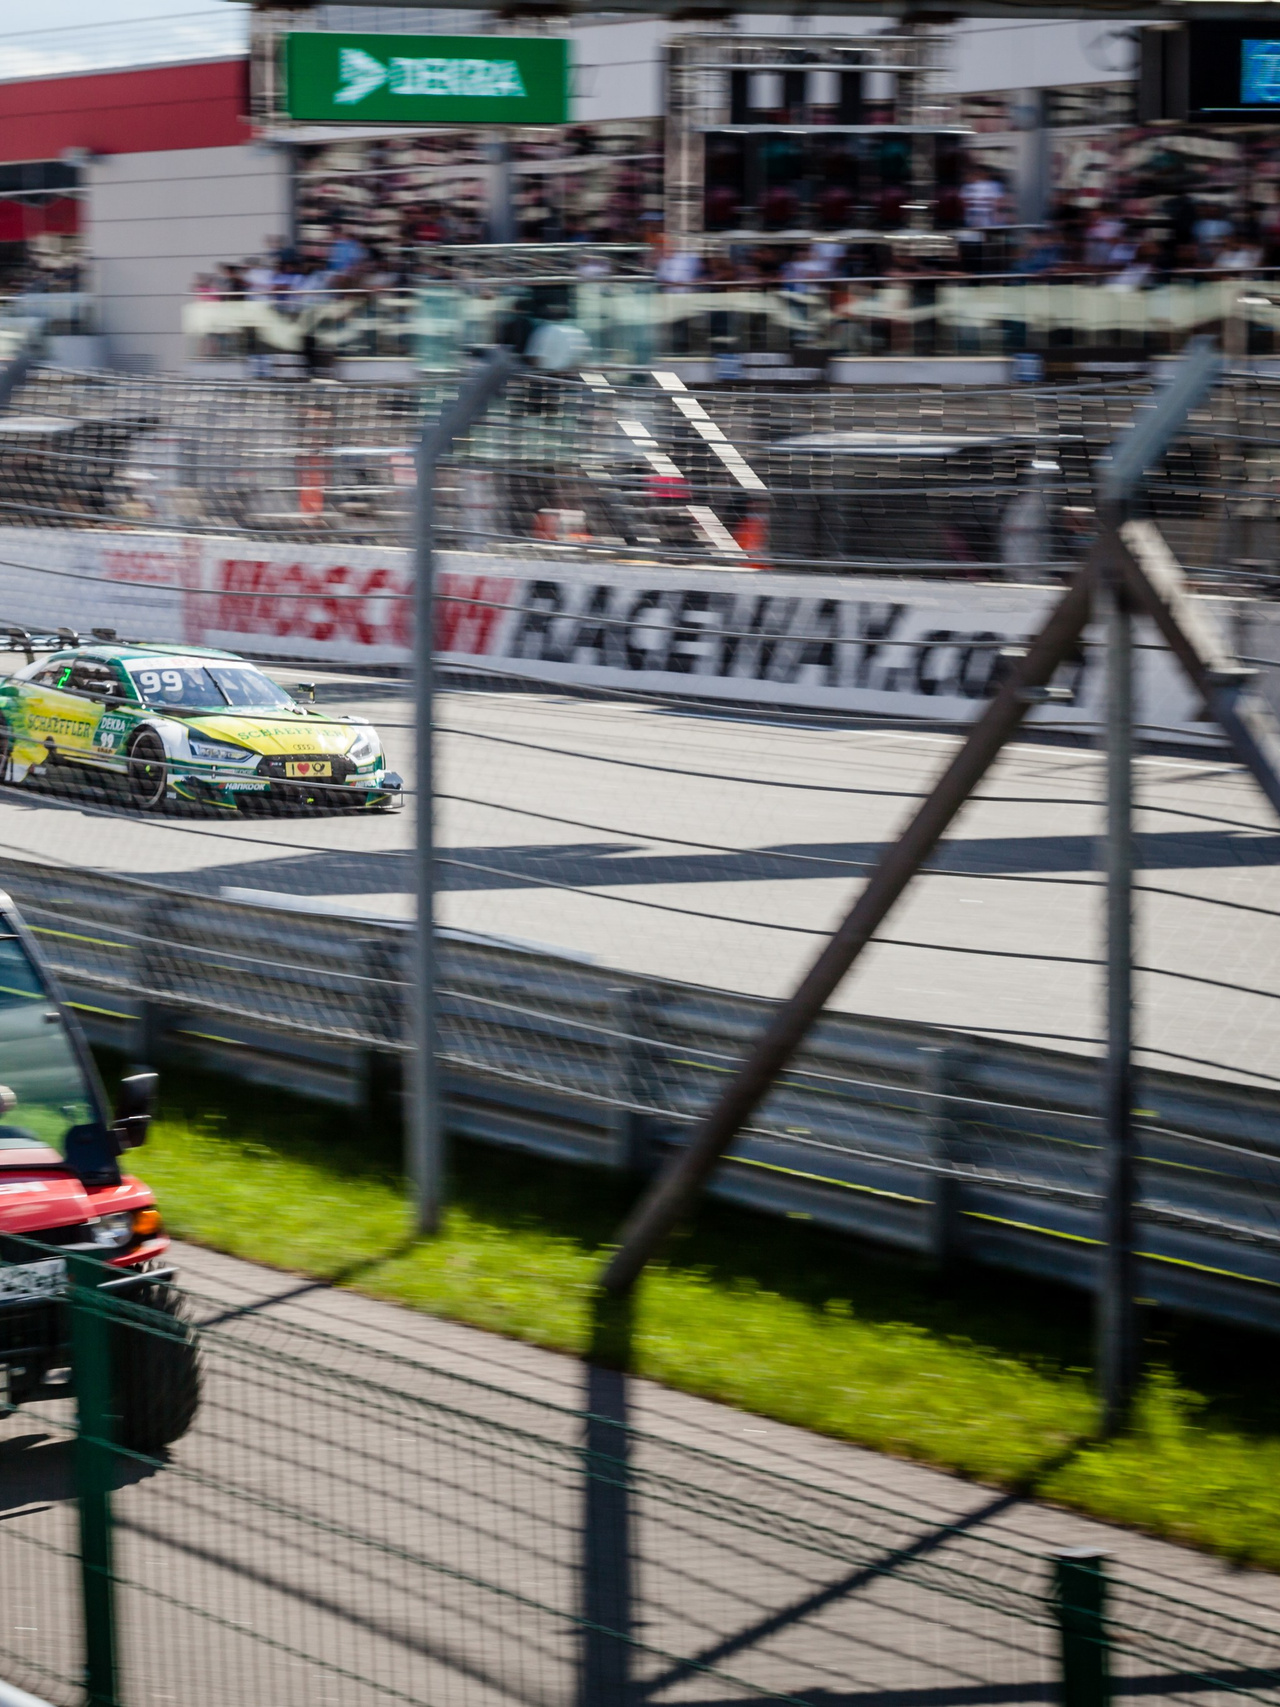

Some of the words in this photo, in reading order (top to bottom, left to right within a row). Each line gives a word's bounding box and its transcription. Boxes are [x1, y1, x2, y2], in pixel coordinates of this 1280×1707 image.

[140, 670, 183, 694] 99
[27, 714, 91, 738] SCHAEFFLER
[101, 717, 126, 732] DEKRA
[100, 732, 124, 748] 99
